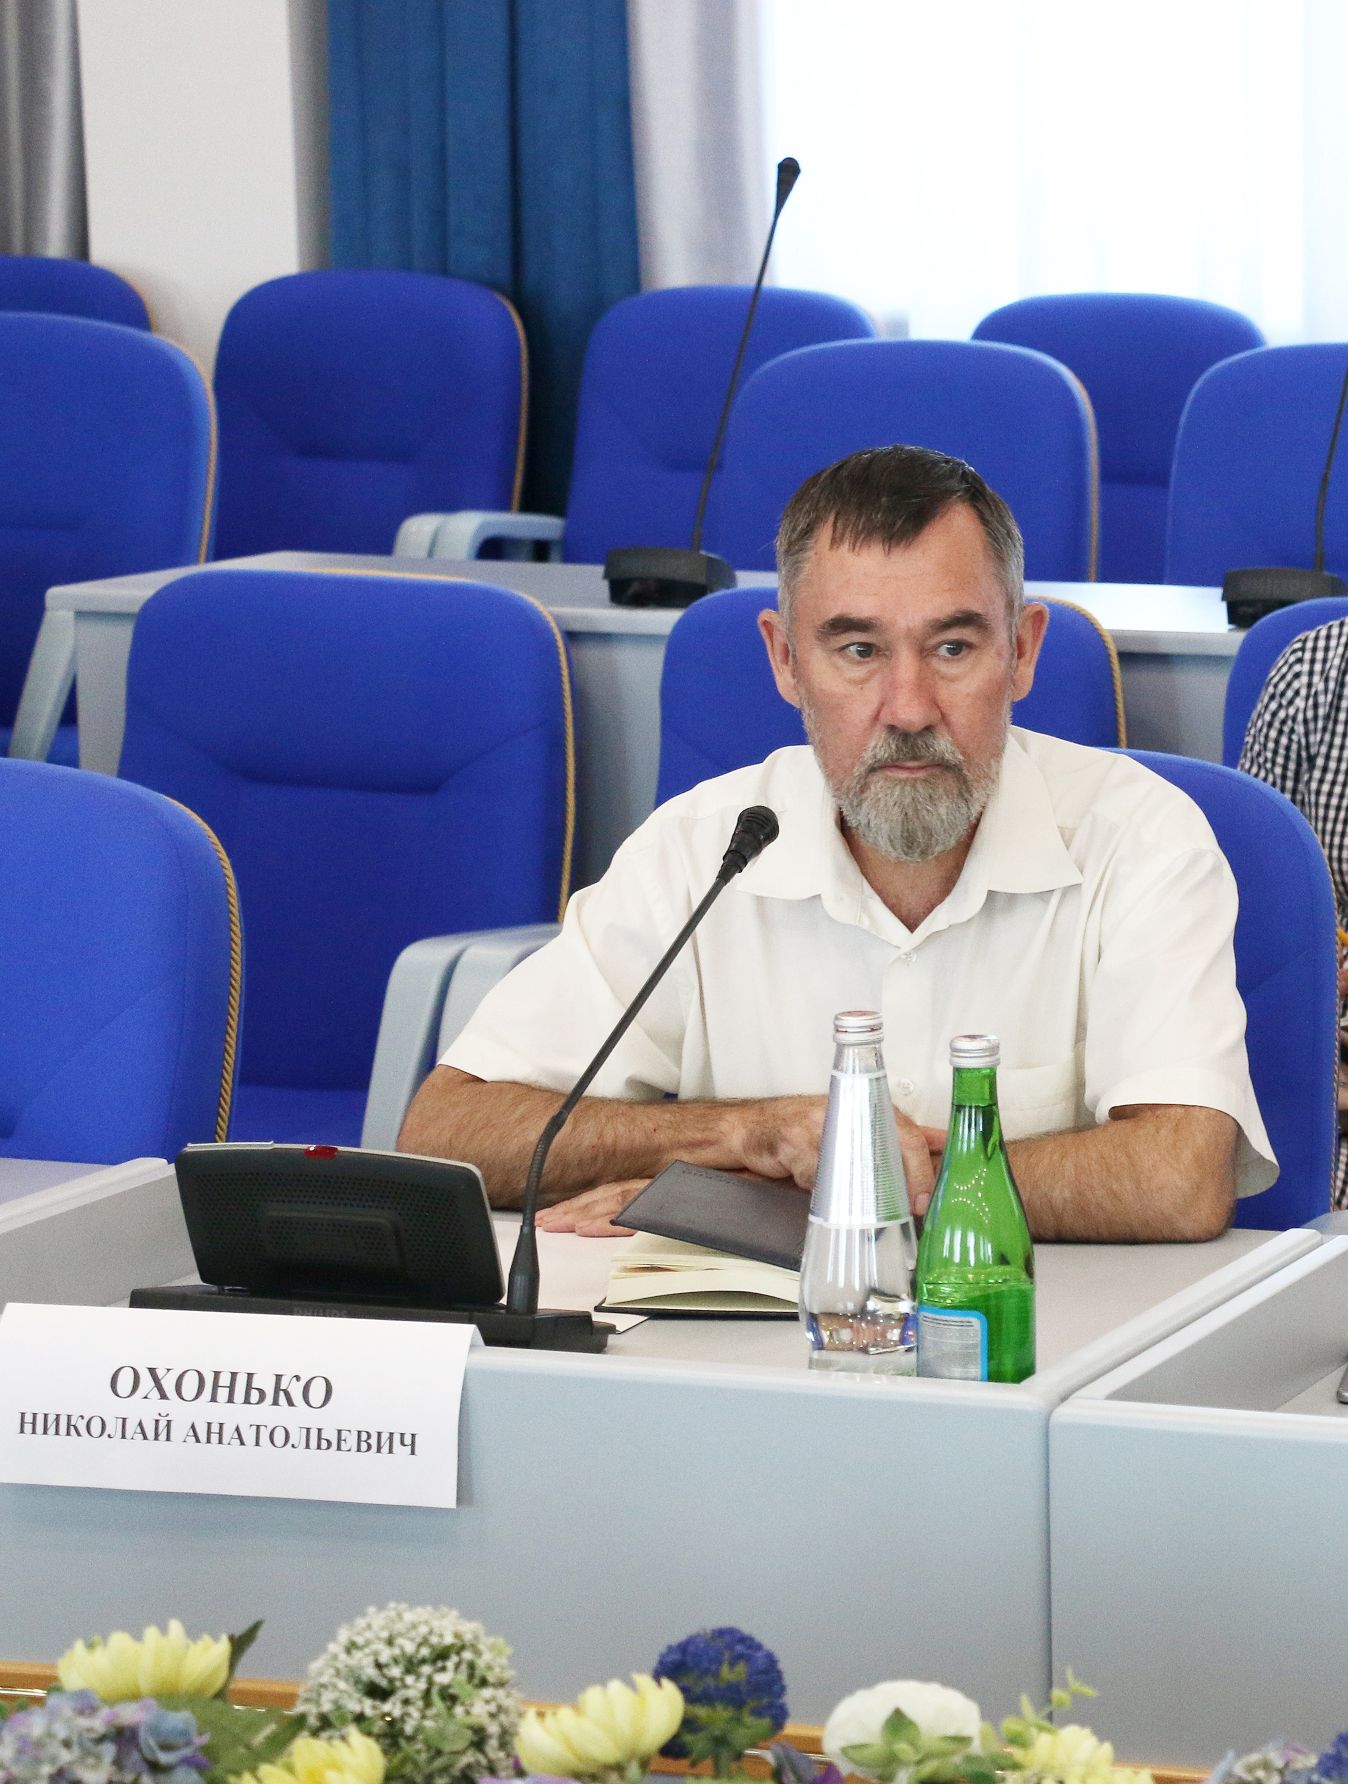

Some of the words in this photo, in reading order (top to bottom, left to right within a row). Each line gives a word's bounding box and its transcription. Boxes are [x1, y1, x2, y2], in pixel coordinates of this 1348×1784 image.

[109, 1365, 334, 1410] ОХОНЬКО
[18, 1411, 173, 1442] НИКОЛАЙ
[182, 1420, 419, 1457] АНАТОЛЬЕВИЧ
